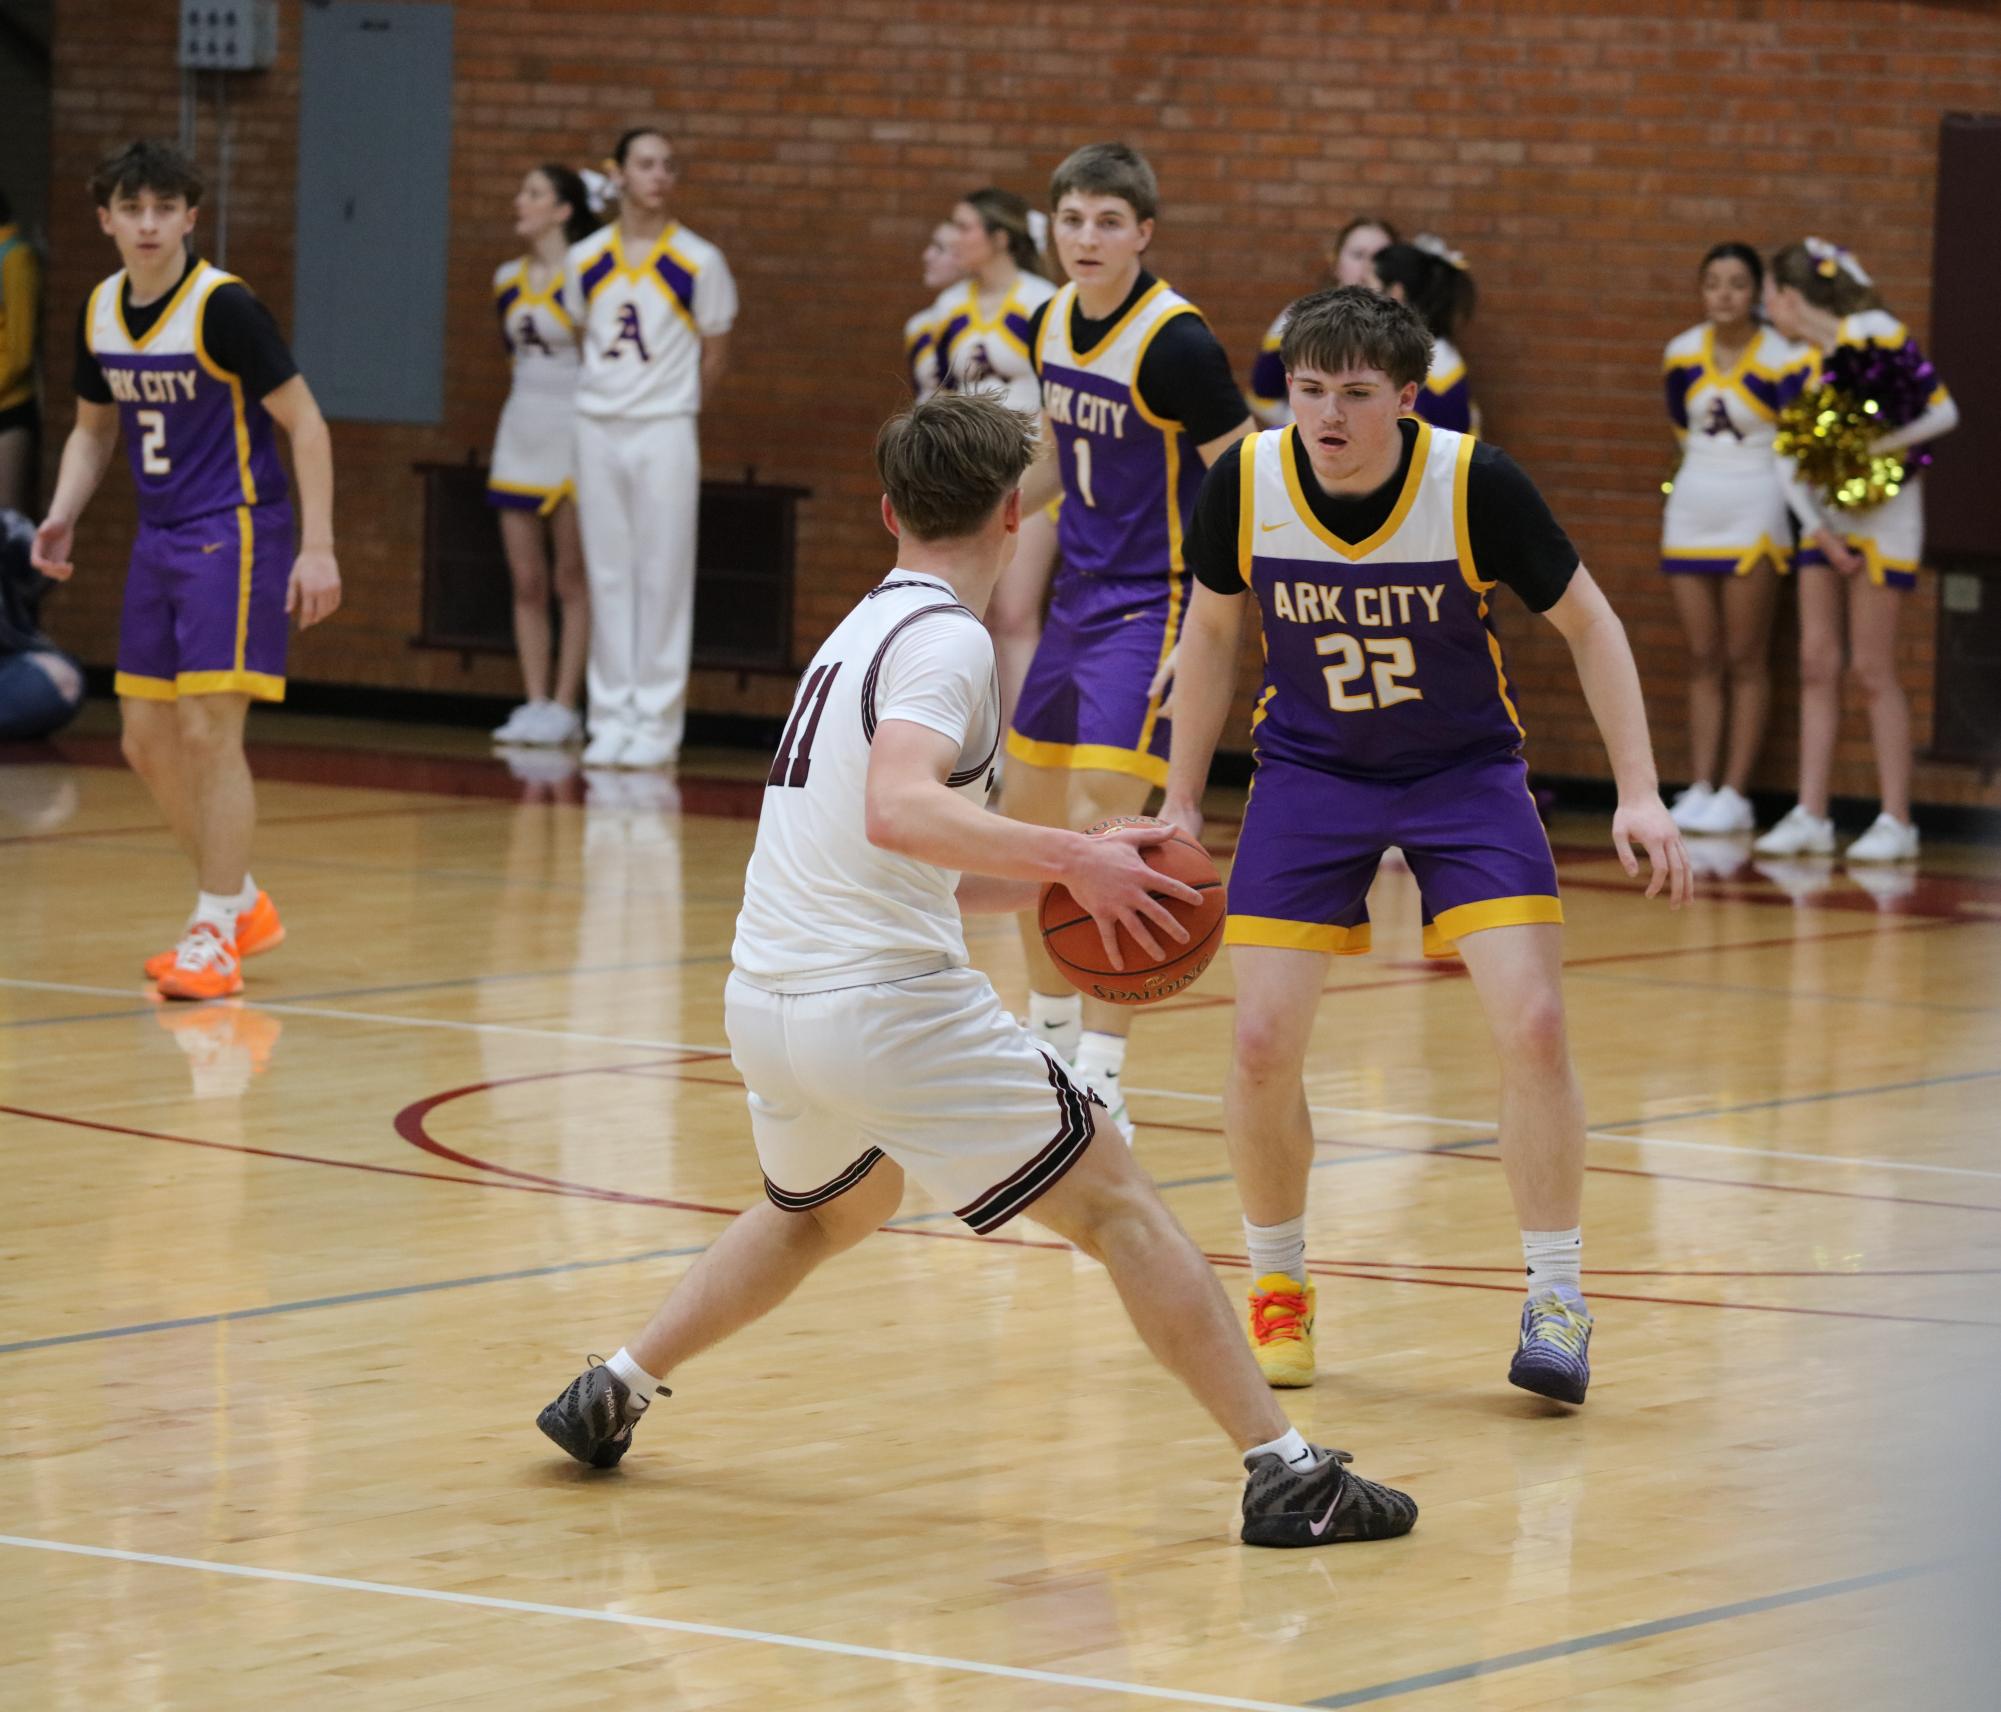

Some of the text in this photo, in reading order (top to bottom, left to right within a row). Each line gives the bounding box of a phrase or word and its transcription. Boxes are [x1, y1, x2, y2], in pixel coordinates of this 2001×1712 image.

[602, 303, 650, 361] A
[140, 369, 197, 403] CITY
[137, 410, 172, 475] 2
[1076, 391, 1129, 439] CITY
[1703, 396, 1746, 442] A
[1073, 437, 1096, 508] 1
[1274, 574, 1446, 627] ARK CITY
[1314, 632, 1424, 713] 22
[767, 661, 843, 789] 11
[1091, 952, 1213, 1001] SPALDING
